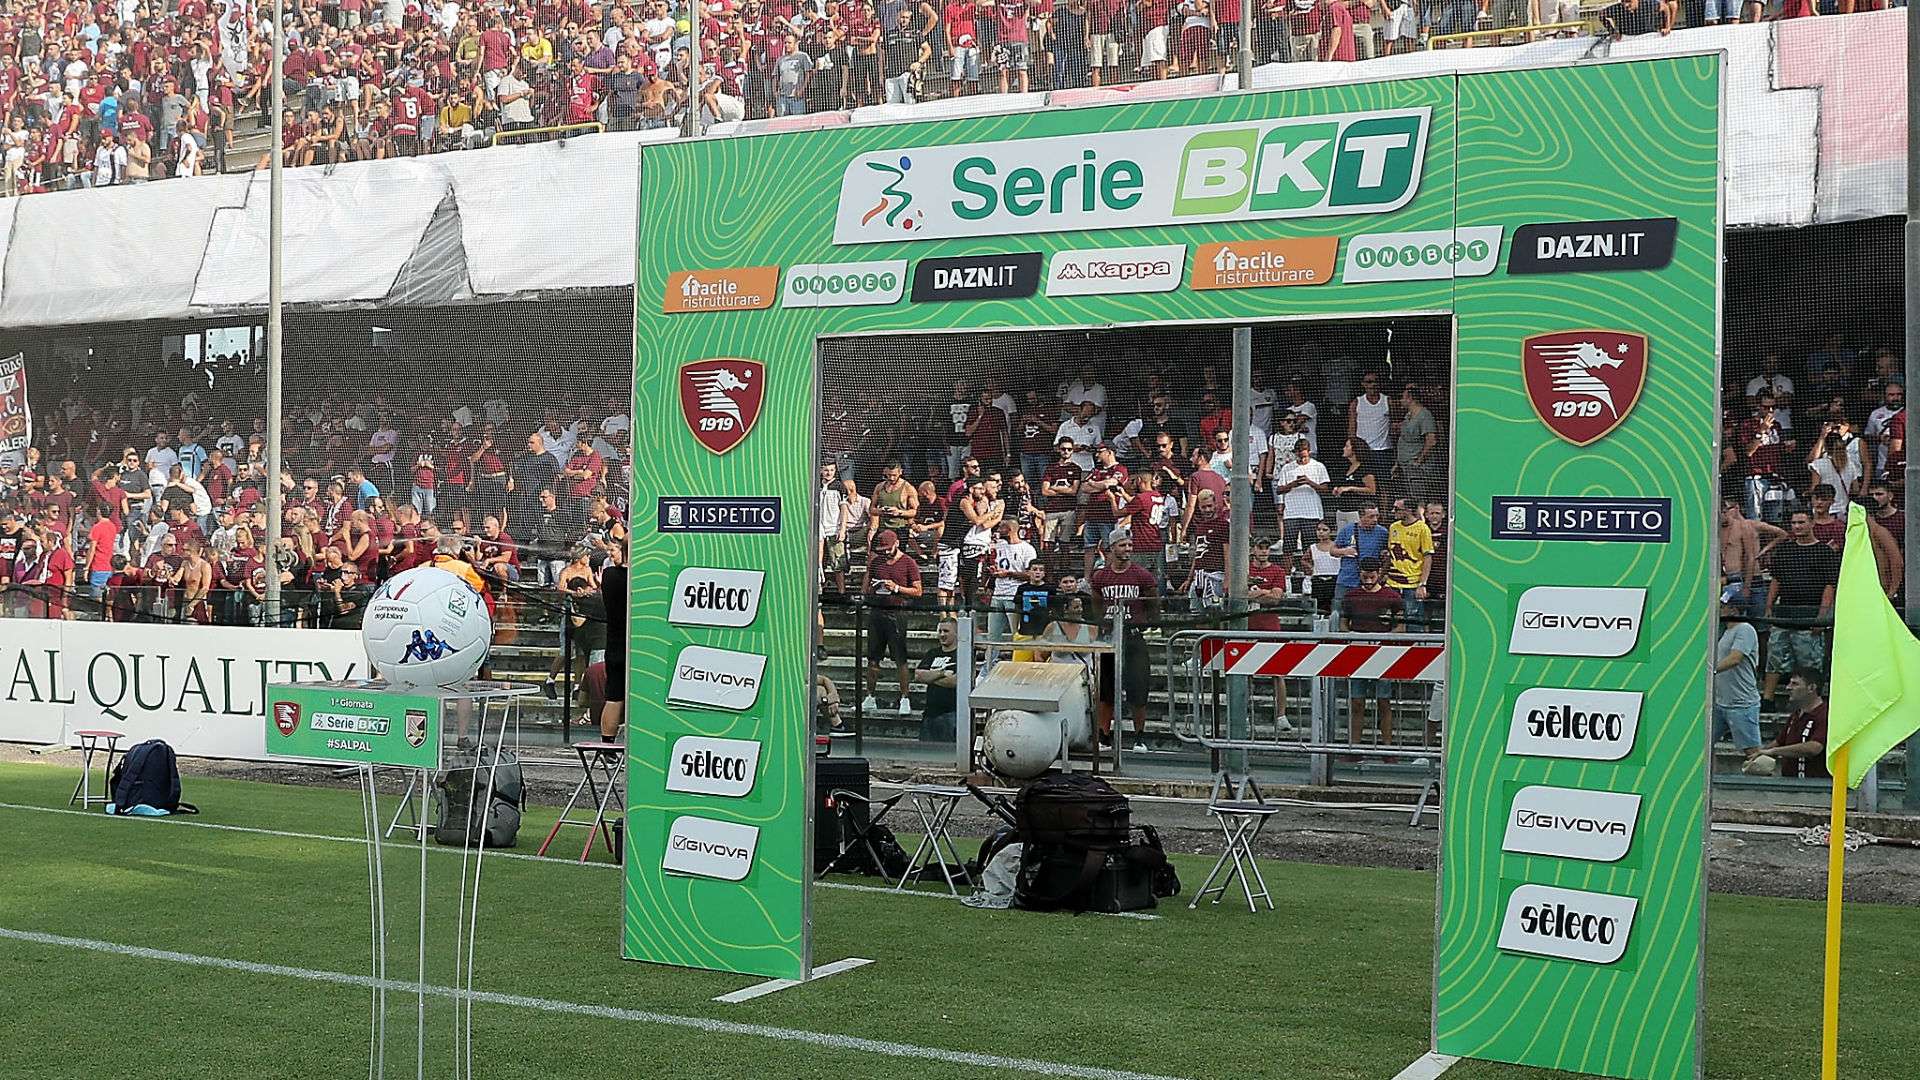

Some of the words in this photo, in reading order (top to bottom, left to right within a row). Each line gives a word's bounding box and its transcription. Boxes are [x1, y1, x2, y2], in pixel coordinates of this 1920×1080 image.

[951, 150, 1144, 220] Serie
[1180, 128, 1413, 202] BKT
[1355, 240, 1489, 267] UNIBET
[1537, 232, 1645, 260] DAZN.IT
[933, 264, 1018, 290] DAZN.IT
[1087, 260, 1171, 280] Kappa
[1214, 263, 1315, 284] ristrutturare
[791, 272, 898, 295] UNIBET
[682, 293, 761, 309] ristrutturare
[1552, 400, 1602, 418] 1919
[699, 416, 734, 432] 1919
[689, 507, 776, 525] RISPETTO
[1537, 509, 1663, 530] RISPETTO
[1542, 615, 1632, 631] GIVOVA
[0, 648, 76, 704] AL
[693, 670, 755, 689] GIVOVA
[340, 699, 374, 709] Giornata
[327, 716, 354, 729] Serie
[358, 719, 388, 732] BKT
[327, 739, 372, 752] #SALPAL
[1536, 814, 1625, 836] GIVOVA
[685, 840, 748, 860] GIVOVA
